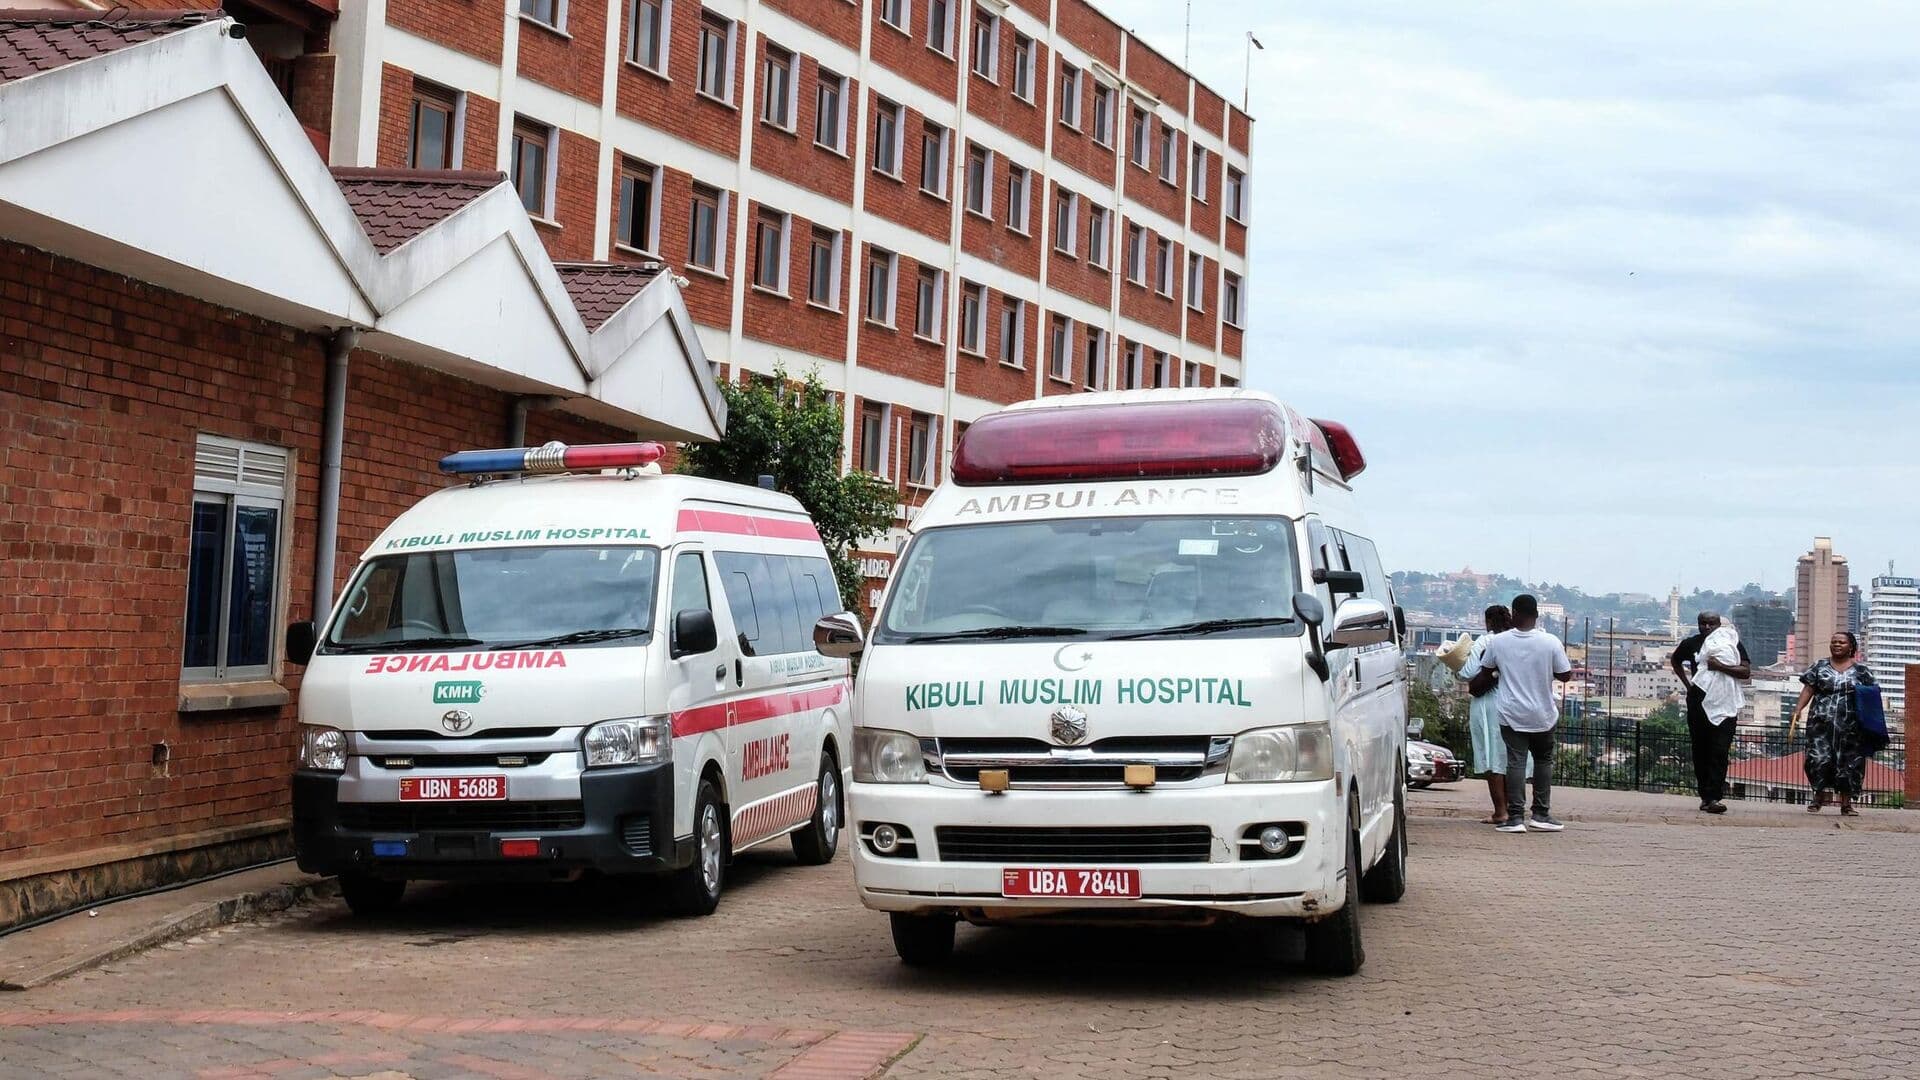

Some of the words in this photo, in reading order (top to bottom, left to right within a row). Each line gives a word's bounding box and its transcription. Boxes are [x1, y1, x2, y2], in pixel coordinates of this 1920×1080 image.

[386, 534, 453, 549] KIBULI
[458, 529, 541, 544] MUSLIM
[546, 528, 652, 540] HOSPITAL
[436, 685, 473, 699] KMH
[906, 680, 984, 711] KIBULI
[999, 678, 1102, 705] MUSLIM
[1117, 678, 1252, 707] HOSPITAL
[741, 733, 789, 783] AMBULANCE
[420, 779, 451, 798] UBN
[459, 778, 498, 798] 568B
[1028, 870, 1068, 894] UBA
[1078, 871, 1130, 894] 784U
